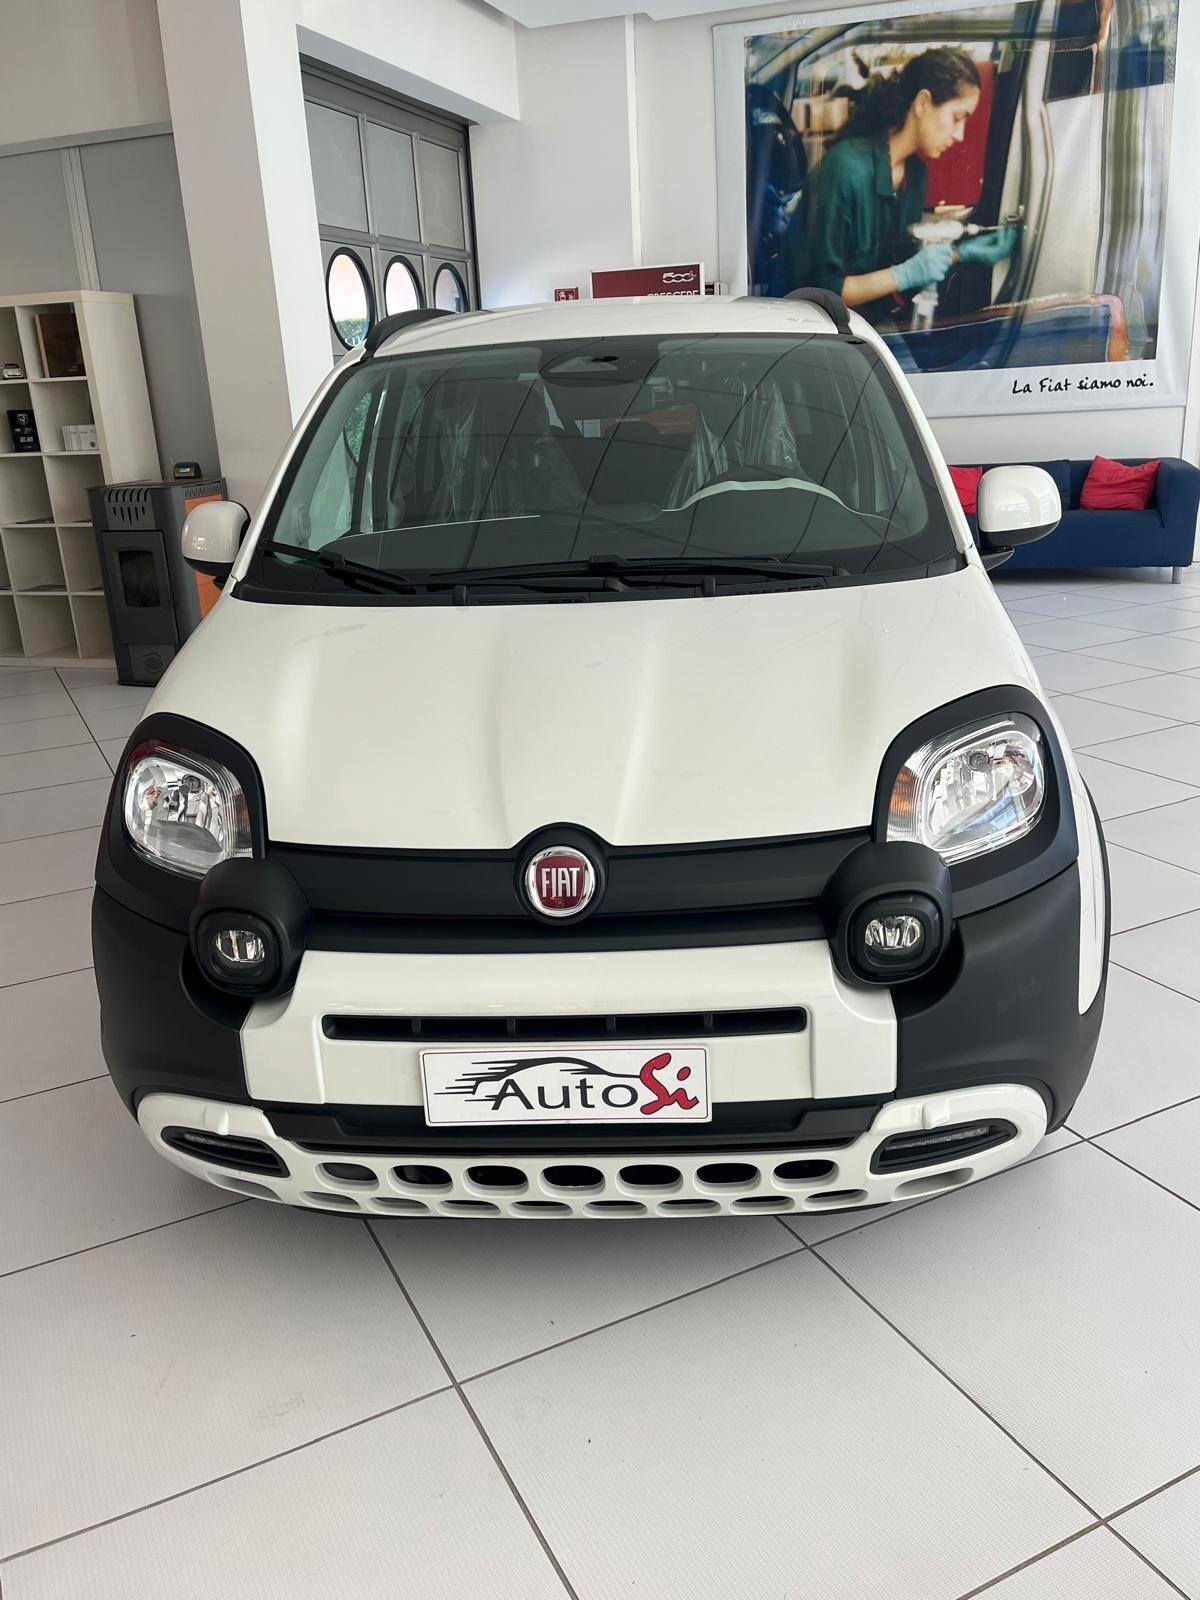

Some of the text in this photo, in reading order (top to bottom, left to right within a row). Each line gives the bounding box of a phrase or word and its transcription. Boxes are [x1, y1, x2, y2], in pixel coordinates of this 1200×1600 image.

[1012, 373, 1154, 394] La Fiat siamo noi.
[541, 867, 580, 898] FIAT
